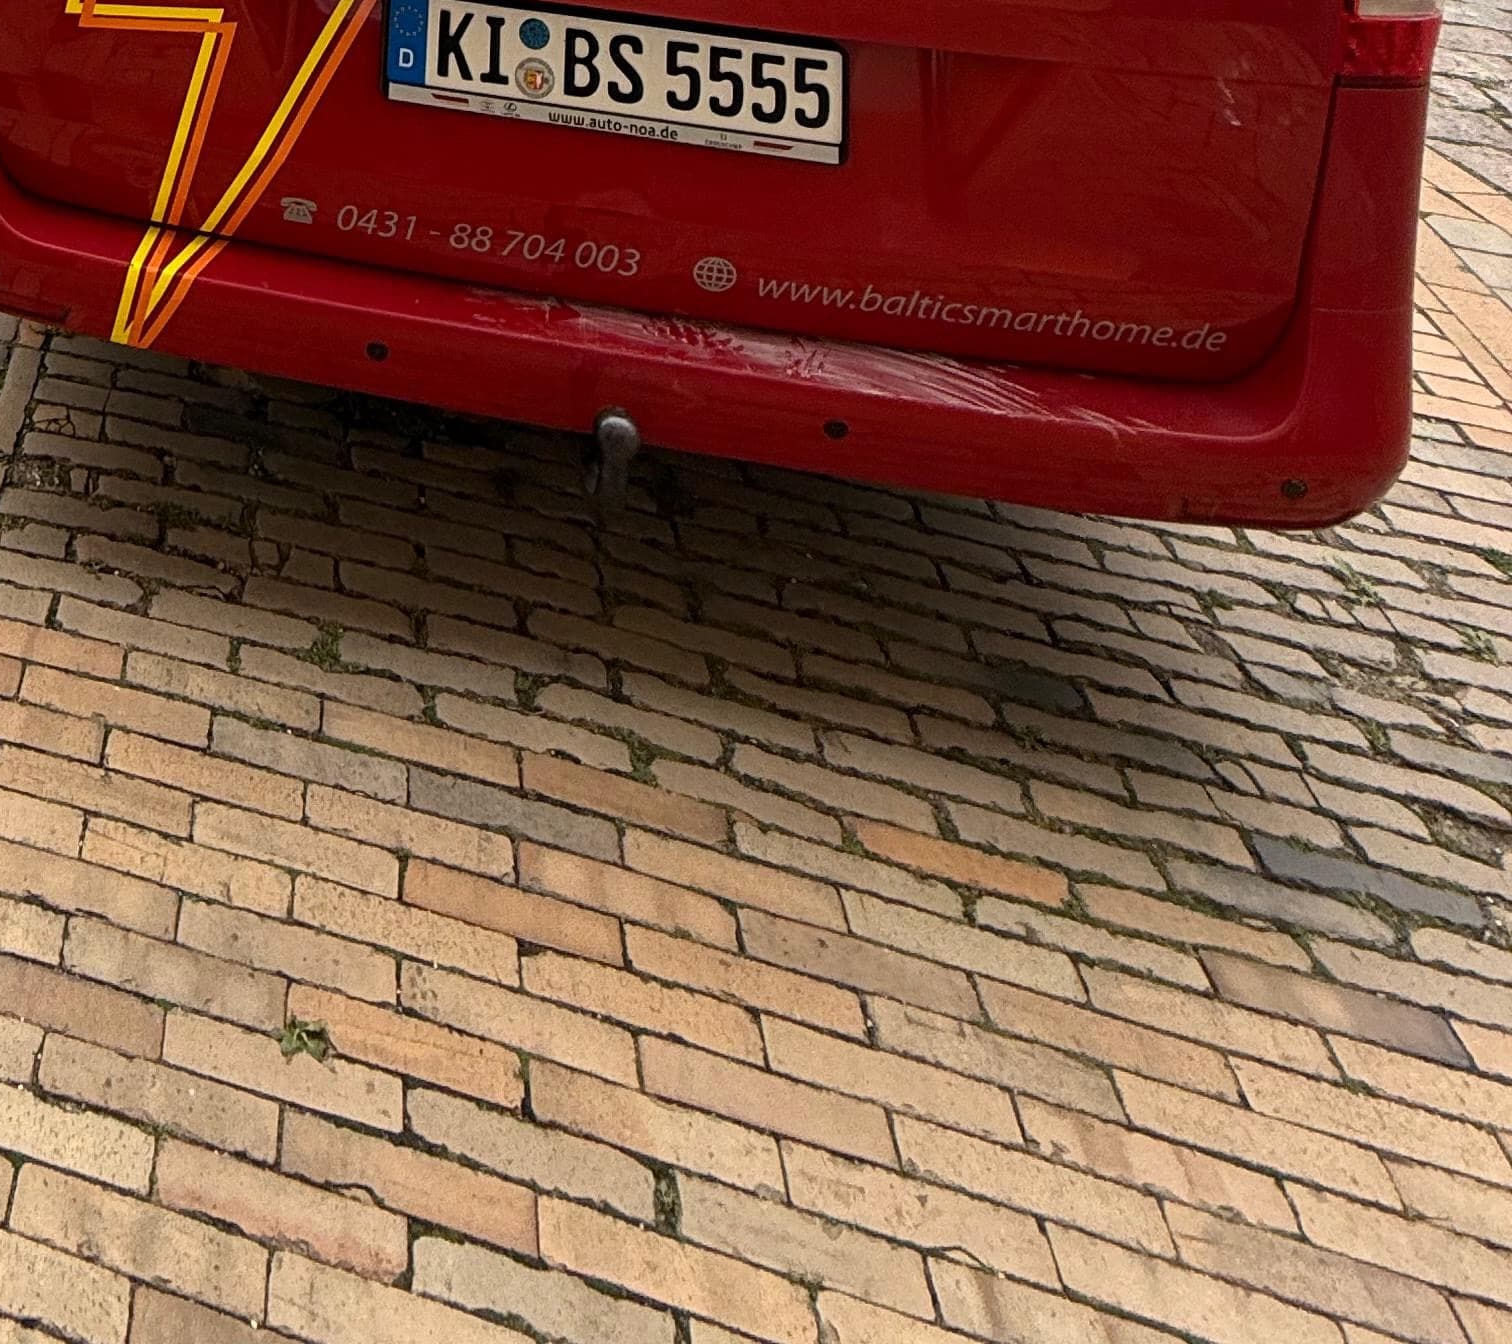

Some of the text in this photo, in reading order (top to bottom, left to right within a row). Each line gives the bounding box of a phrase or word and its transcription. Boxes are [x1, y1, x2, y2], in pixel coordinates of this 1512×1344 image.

[399, 47, 414, 68] D
[435, 9, 830, 129] KI BS 5555
[548, 111, 678, 141] www.auto-noa.de
[336, 204, 417, 241] 0431
[449, 223, 492, 252] 88
[502, 229, 566, 263] 704
[574, 241, 641, 277] 003
[756, 274, 1228, 352] www.balticsmarthome.de
